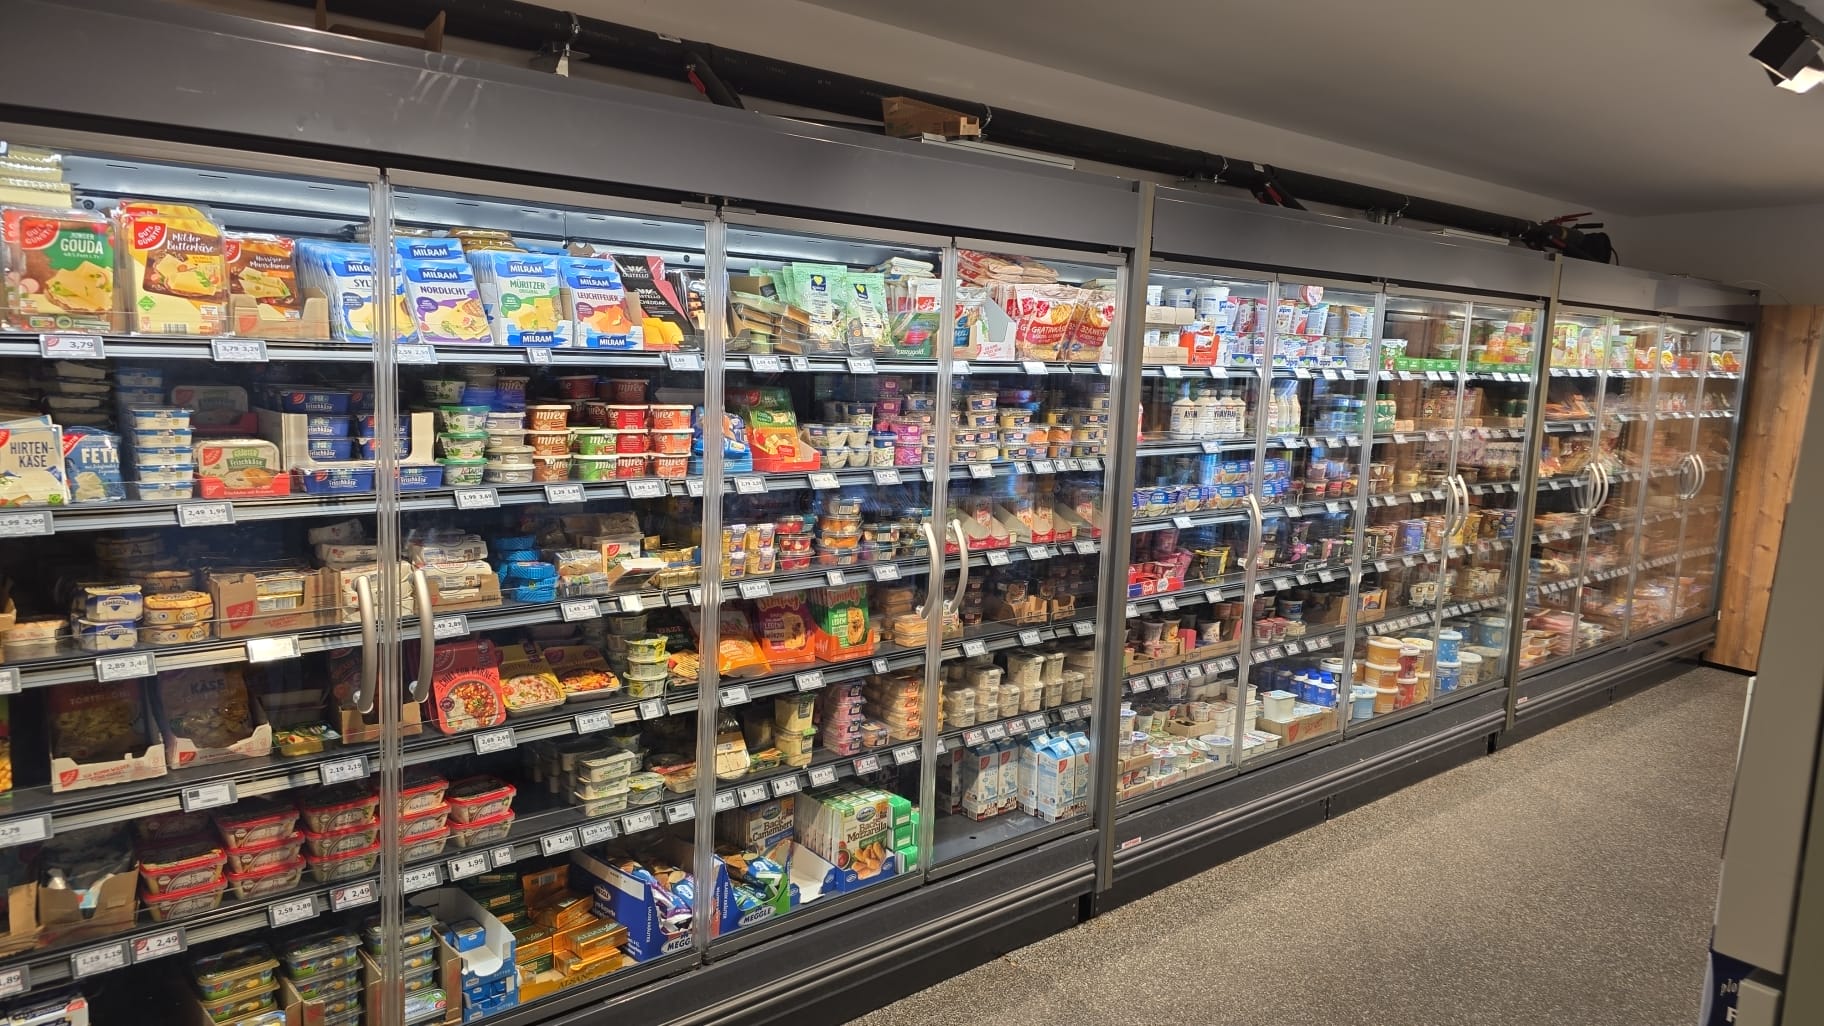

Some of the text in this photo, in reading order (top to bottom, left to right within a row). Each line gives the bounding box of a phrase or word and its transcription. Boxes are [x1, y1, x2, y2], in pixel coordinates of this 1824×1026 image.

[172, 232, 202, 243] Milder
[60, 238, 104, 256] GOUDA
[166, 241, 216, 255] Butterkäse
[413, 247, 448, 258] MILRAM
[509, 262, 543, 273] MILRAM
[422, 269, 458, 280] MILRAM
[509, 279, 547, 290] MÜRITZER
[579, 278, 610, 287] MILRAM
[419, 285, 466, 296] NORDLICHT
[577, 291, 620, 302] LEUCHTFEUER
[522, 333, 552, 344] MILRAM
[599, 338, 625, 347] MILRAM
[69, 341, 95, 350] 3,79
[536, 410, 566, 421] miree
[538, 434, 566, 445] miree
[10, 441, 54, 455] HIRTEN-
[18, 454, 48, 468] KÄSE
[81, 447, 119, 464] FETA
[618, 457, 644, 468] miree
[659, 458, 686, 468] miree
[188, 508, 206, 518] 2,49
[190, 678, 226, 694] KÄSE
[763, 818, 784, 832] Back
[752, 820, 793, 842] Camembert
[847, 821, 887, 843] Mozzarella
[468, 858, 484, 868] 1,99
[351, 888, 370, 898] 2,49
[742, 906, 773, 924] MEGGLE
[156, 937, 178, 947] 2,49
